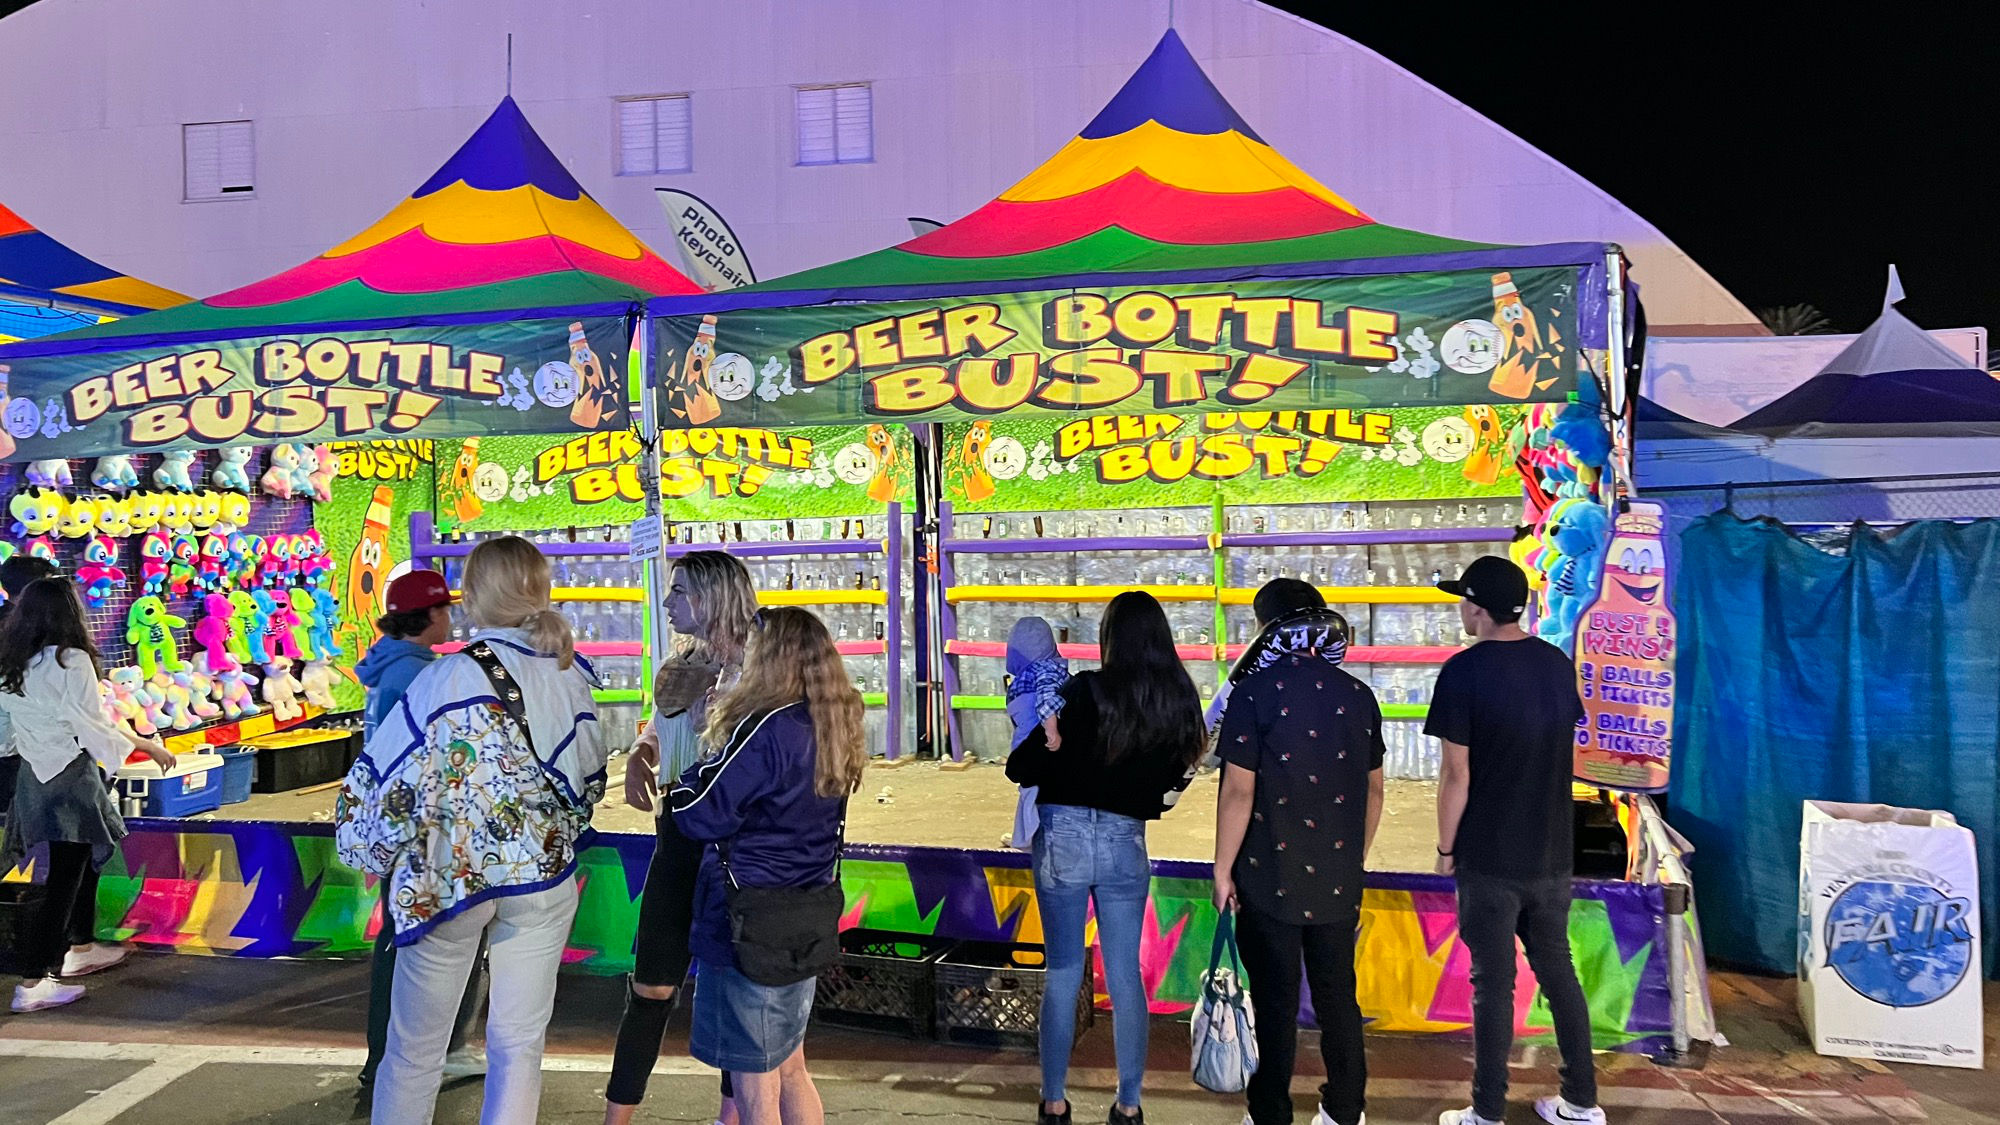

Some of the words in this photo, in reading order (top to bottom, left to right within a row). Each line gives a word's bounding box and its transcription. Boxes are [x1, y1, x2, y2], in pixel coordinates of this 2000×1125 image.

[682, 206, 735, 257] Photo
[793, 303, 1018, 388] BEER
[1044, 291, 1397, 363] BOTTLE
[66, 349, 236, 424] BEER
[256, 337, 503, 398] BOTTLE
[866, 348, 1309, 414] BUST!
[124, 384, 443, 446] BUST!
[1054, 414, 1184, 461] BEER
[338, 450, 418, 480] BUST!
[534, 431, 642, 484] BEER
[660, 428, 813, 470] BOTTLE
[1095, 433, 1344, 484] BUST!
[1584, 630, 1675, 661] WINS!
[1589, 612, 1649, 635] BUST
[1584, 683, 1594, 699] 5
[1600, 684, 1672, 708] TICKETS
[1601, 665, 1673, 689] BALLS
[1597, 713, 1668, 738] BALLS
[1597, 732, 1669, 757] TICKETS
[1823, 897, 1975, 967] FAIR
